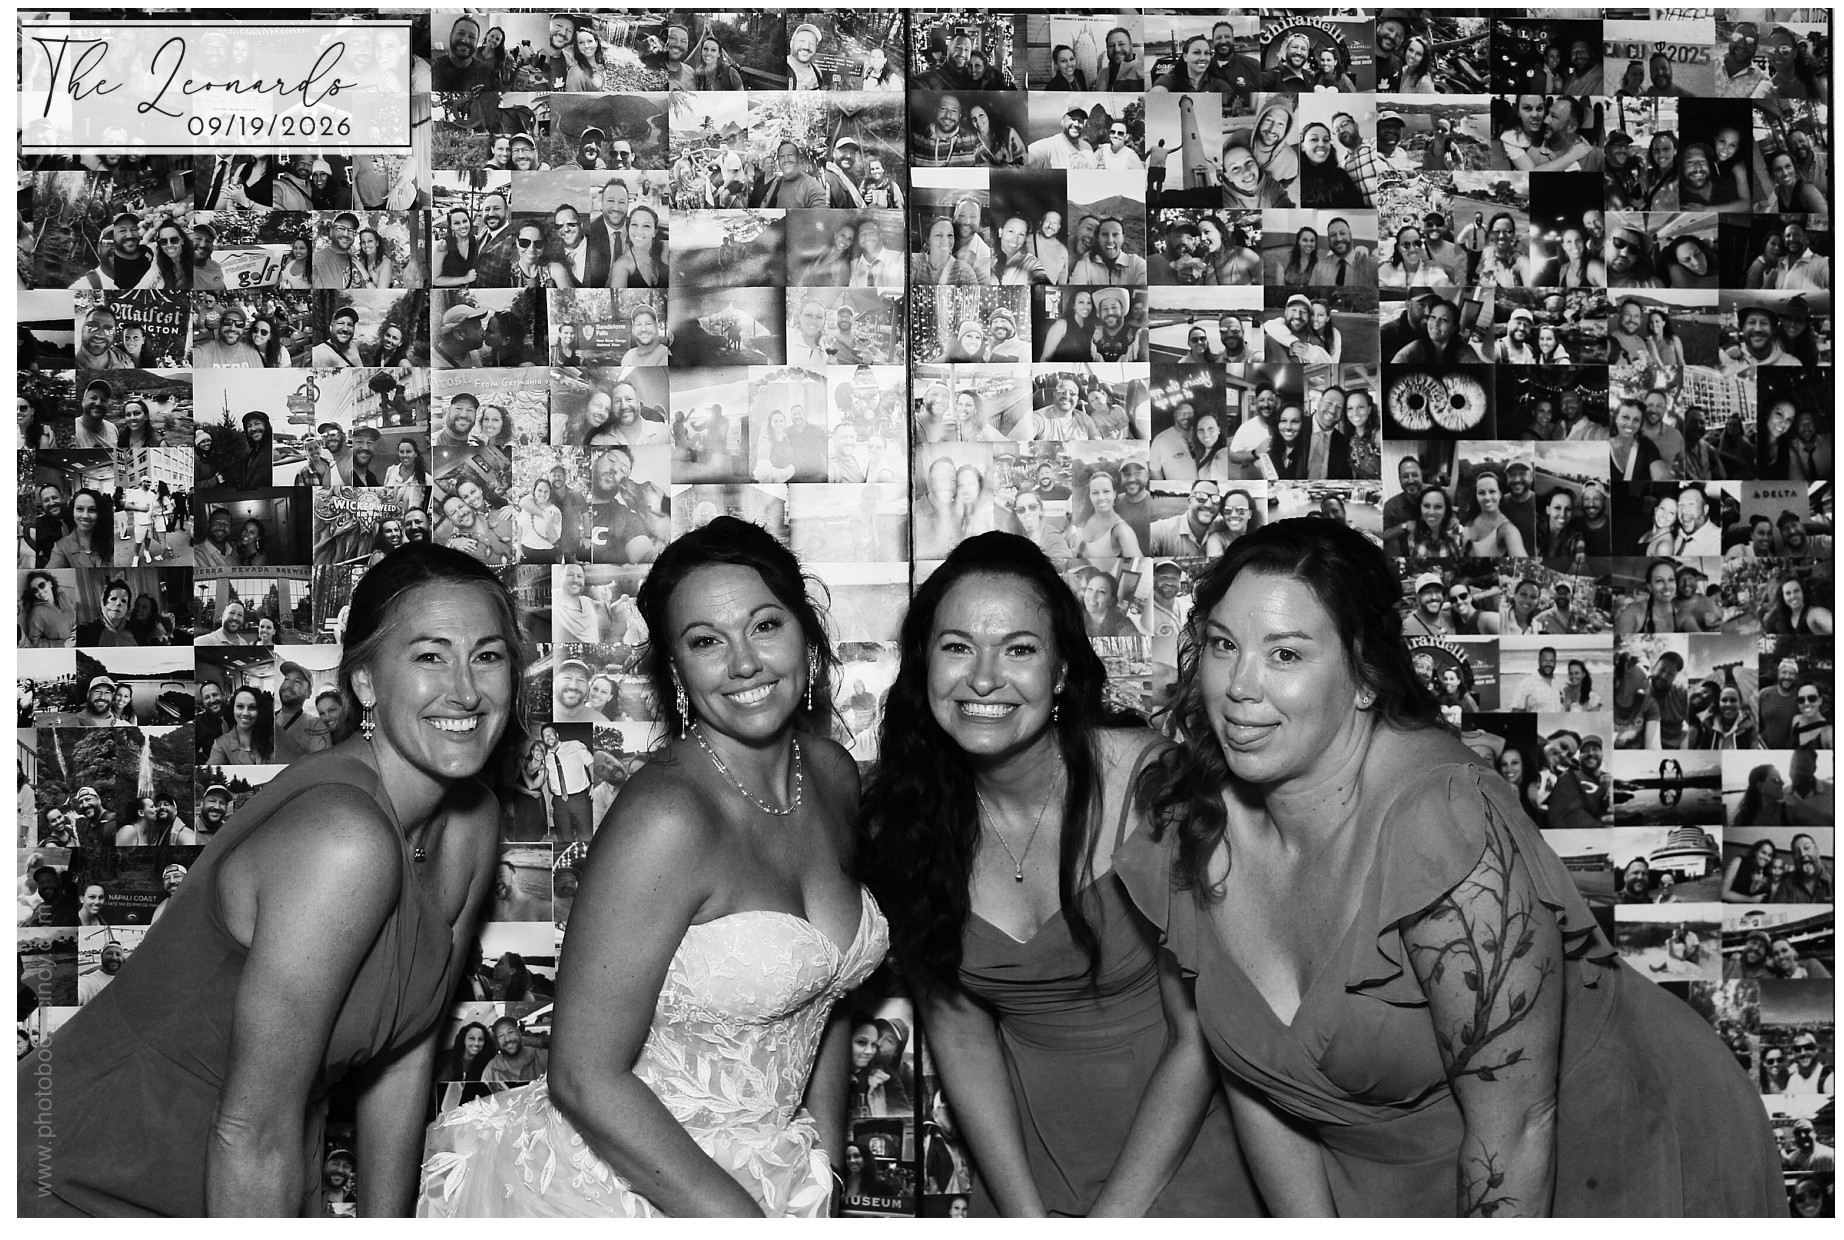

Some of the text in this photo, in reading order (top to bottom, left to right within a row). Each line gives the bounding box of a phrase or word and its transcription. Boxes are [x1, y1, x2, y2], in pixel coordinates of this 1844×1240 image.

[1259, 15, 1346, 45] Ghirardelli
[1668, 45, 1711, 65] 2025
[110, 302, 183, 325] Maifest
[474, 378, 499, 389] From
[501, 377, 542, 388] Germania
[1762, 489, 1798, 498] DELTA
[333, 499, 397, 512] WICKED WEED
[1402, 633, 1469, 664] irardelli
